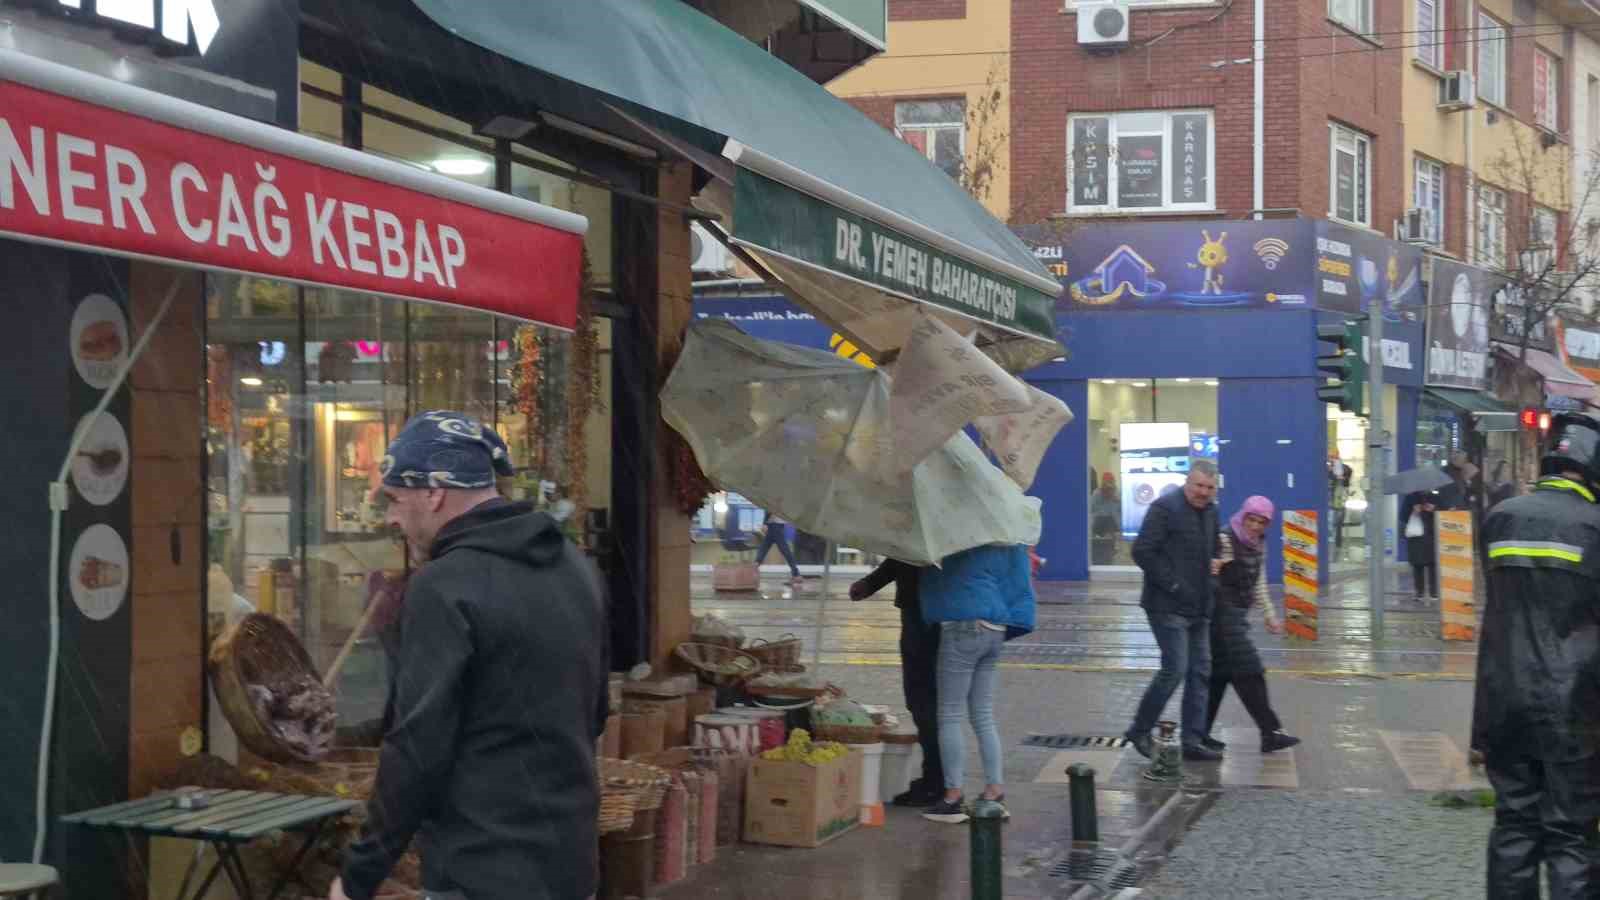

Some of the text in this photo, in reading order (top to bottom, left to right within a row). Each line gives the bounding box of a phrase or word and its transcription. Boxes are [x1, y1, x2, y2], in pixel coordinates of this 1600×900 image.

[170, 161, 292, 258] CAĞ
[304, 192, 466, 290] KEBAP
[835, 217, 867, 271] DR.
[871, 231, 929, 289] YEMEN
